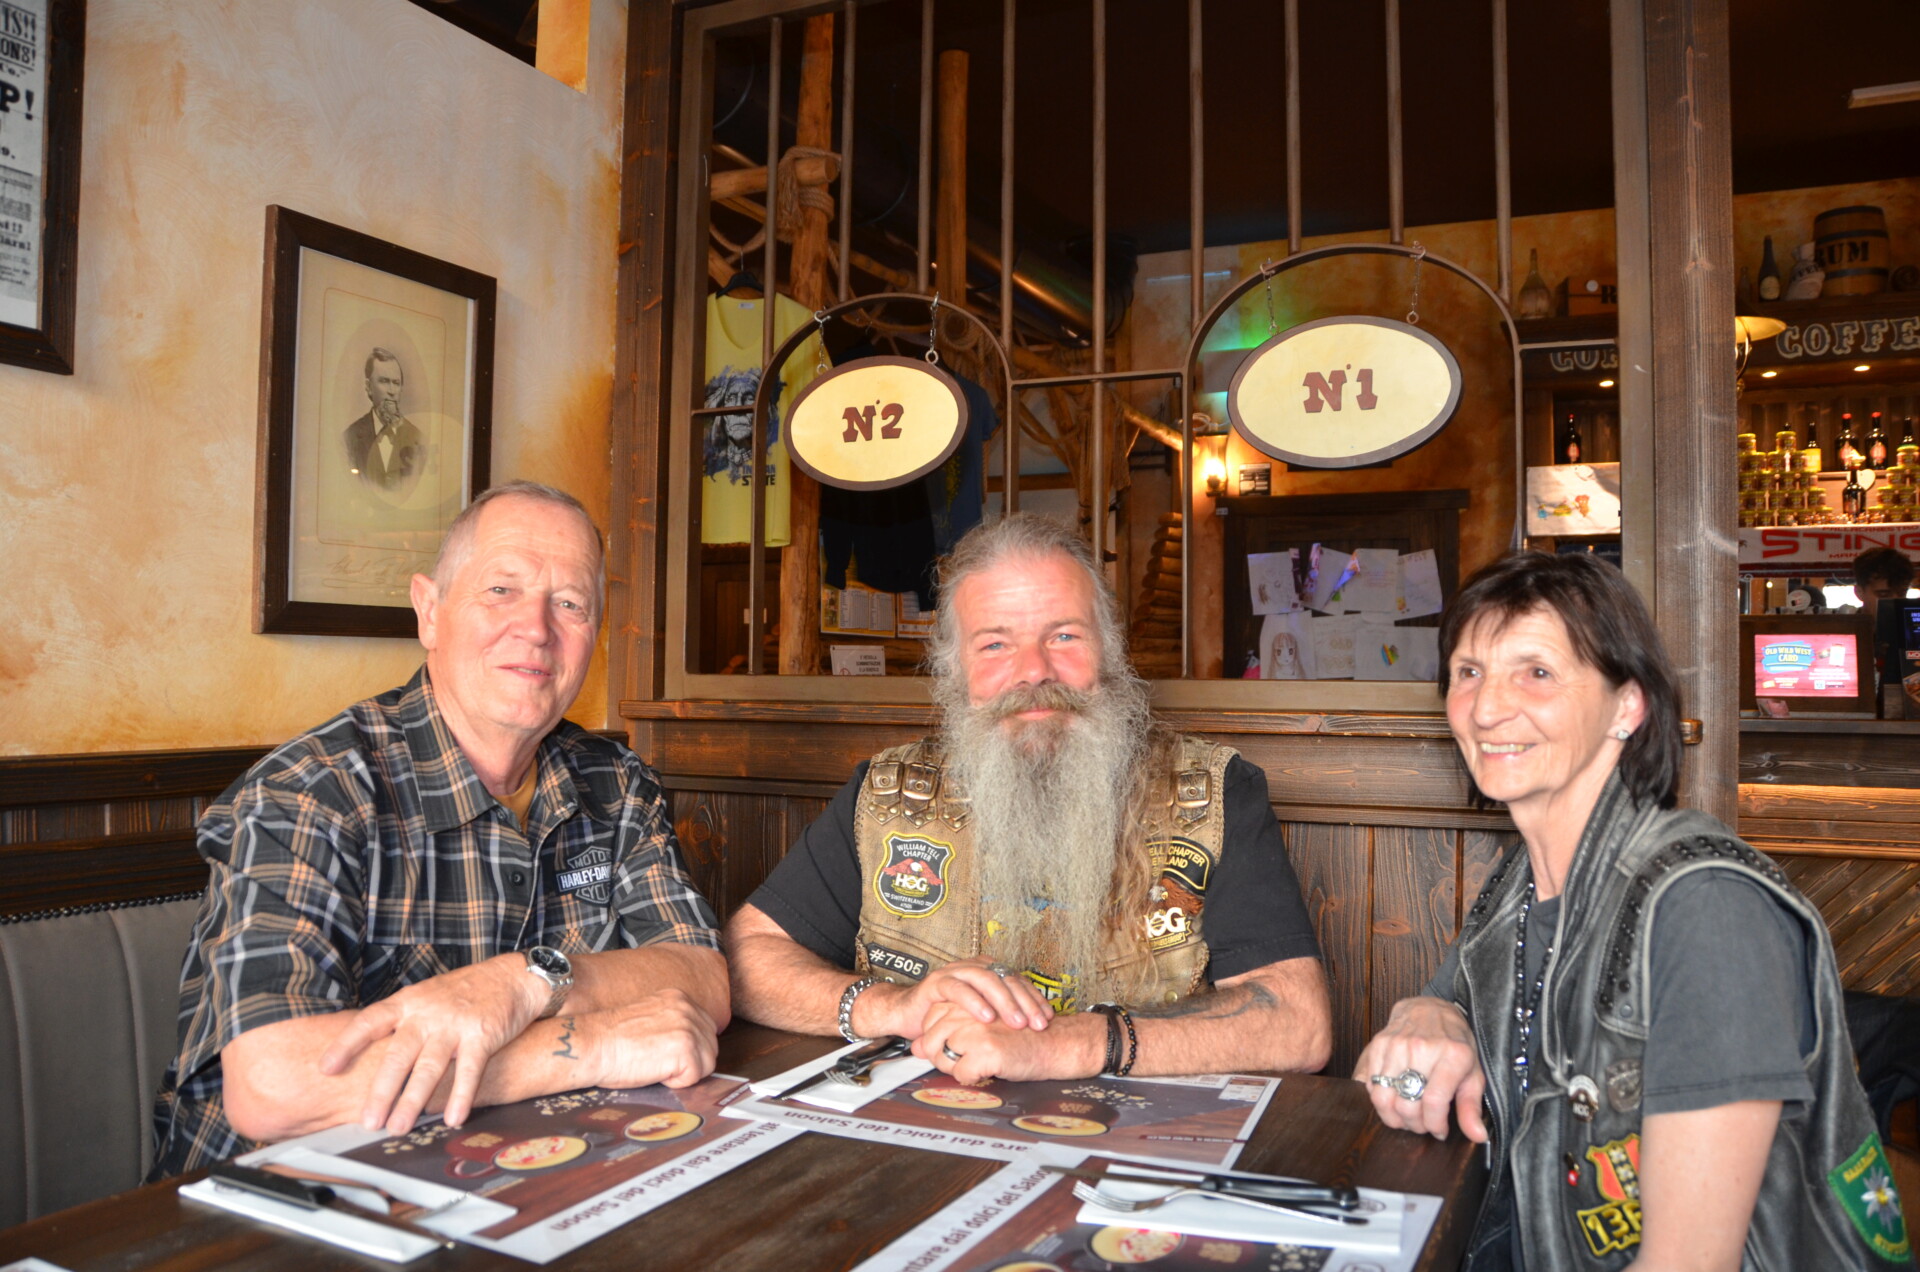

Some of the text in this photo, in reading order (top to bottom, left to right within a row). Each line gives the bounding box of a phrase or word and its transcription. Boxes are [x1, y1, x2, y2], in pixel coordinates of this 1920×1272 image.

[896, 843, 941, 860] WILLIAM TELL
[902, 850, 932, 862] CHAPTER
[1168, 845, 1206, 867] CHAPTER
[869, 949, 923, 975] #7505
[783, 1111, 852, 1128] Saloon
[856, 1122, 890, 1133] del
[892, 1128, 946, 1140] dolci
[950, 1136, 985, 1146] dai
[707, 1130, 764, 1156] tentare
[682, 1154, 711, 1169] dai
[642, 1167, 686, 1188] dolci
[613, 1186, 645, 1202] del
[550, 1200, 620, 1231] Saloon
[942, 1228, 973, 1245] dai
[963, 1205, 1004, 1229] dolci
[994, 1191, 1022, 1206] del
[1010, 1169, 1053, 1192] Saloo
